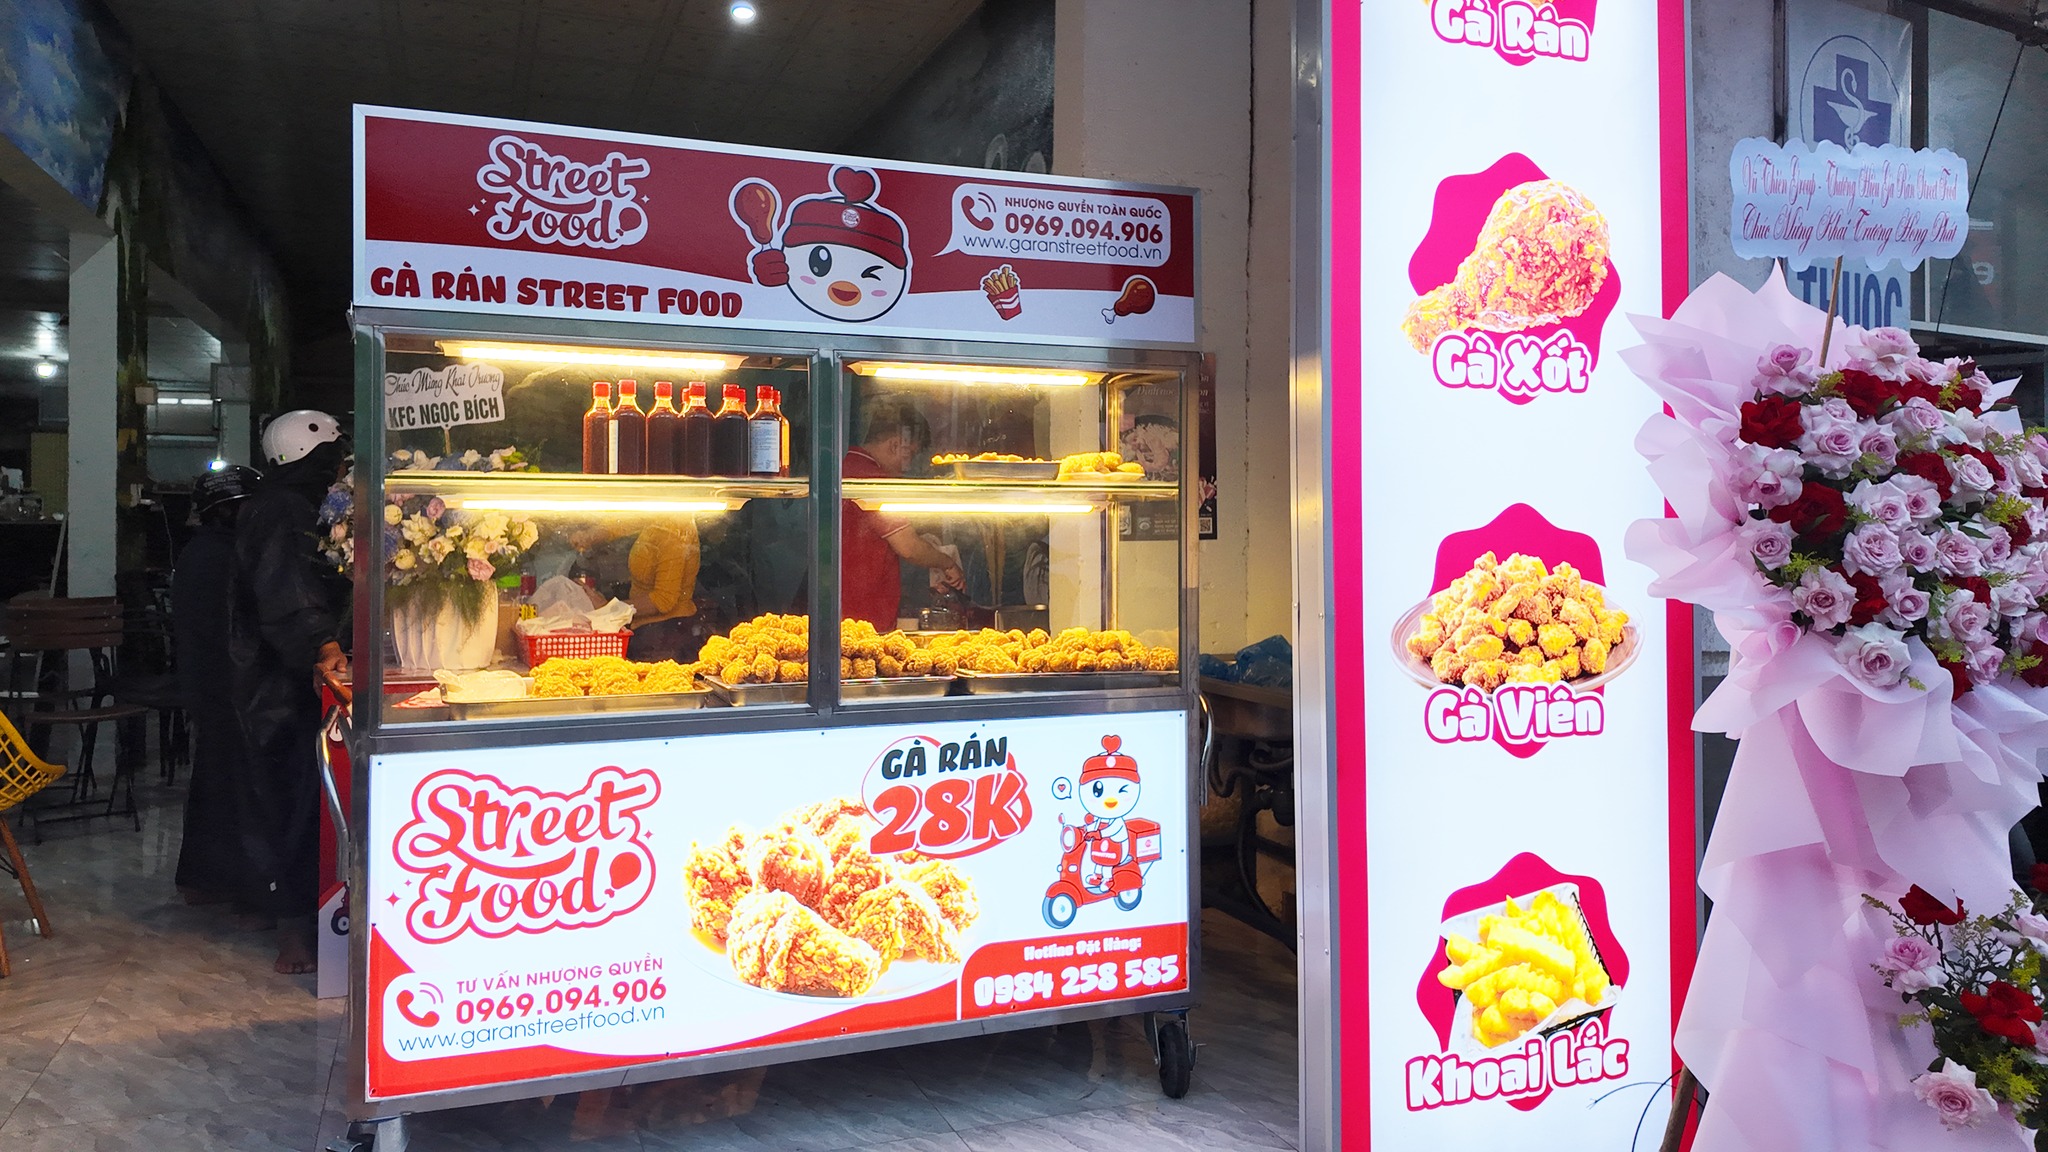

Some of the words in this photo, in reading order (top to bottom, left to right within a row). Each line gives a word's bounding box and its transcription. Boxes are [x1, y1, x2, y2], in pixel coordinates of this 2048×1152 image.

[1432, 0, 1494, 47] Gà
[1501, 3, 1588, 61] Rán
[483, 141, 647, 202] Street
[492, 199, 614, 244] Food
[1005, 197, 1054, 211] NHƯỢNG
[1097, 204, 1127, 217] TOÀN
[1129, 205, 1162, 219] QUỐC
[1005, 213, 1163, 244] 0969.094.906
[1743, 203, 1770, 241] Chúc
[1816, 205, 1851, 241] Khai
[963, 235, 1162, 260] www.garanstreetfood.vn
[371, 261, 421, 298] GÀ
[432, 266, 506, 303] RÁN
[517, 275, 648, 312] STREET
[658, 288, 743, 318] FOOD
[445, 366, 465, 396] Khai
[1433, 331, 1498, 389] Gà
[1502, 329, 1589, 393] Xốt
[389, 405, 415, 428] KFC
[419, 401, 460, 427] NGỌC
[463, 394, 500, 421] BÍCH
[1424, 686, 1490, 744] Gà
[1496, 685, 1604, 740] Viên
[881, 739, 927, 780] GÀ
[939, 732, 1008, 773] RÁN
[408, 780, 648, 858] Street
[869, 770, 1023, 855] 28K
[421, 847, 608, 929] Food
[456, 979, 477, 994] TƯ
[483, 969, 520, 990] VẤN
[526, 964, 603, 987] NHƯỢNG
[608, 953, 663, 977] QUYỀN
[1024, 943, 1074, 961] Hotline
[1076, 939, 1101, 956] Đặt
[455, 976, 667, 1025] 0969.094.906
[974, 969, 1054, 1008] 0984
[1060, 962, 1118, 997] 258
[1124, 954, 1180, 993] 585
[398, 1004, 666, 1052] www.garanstreetfood.vn
[1405, 1038, 1545, 1112] Khoai
